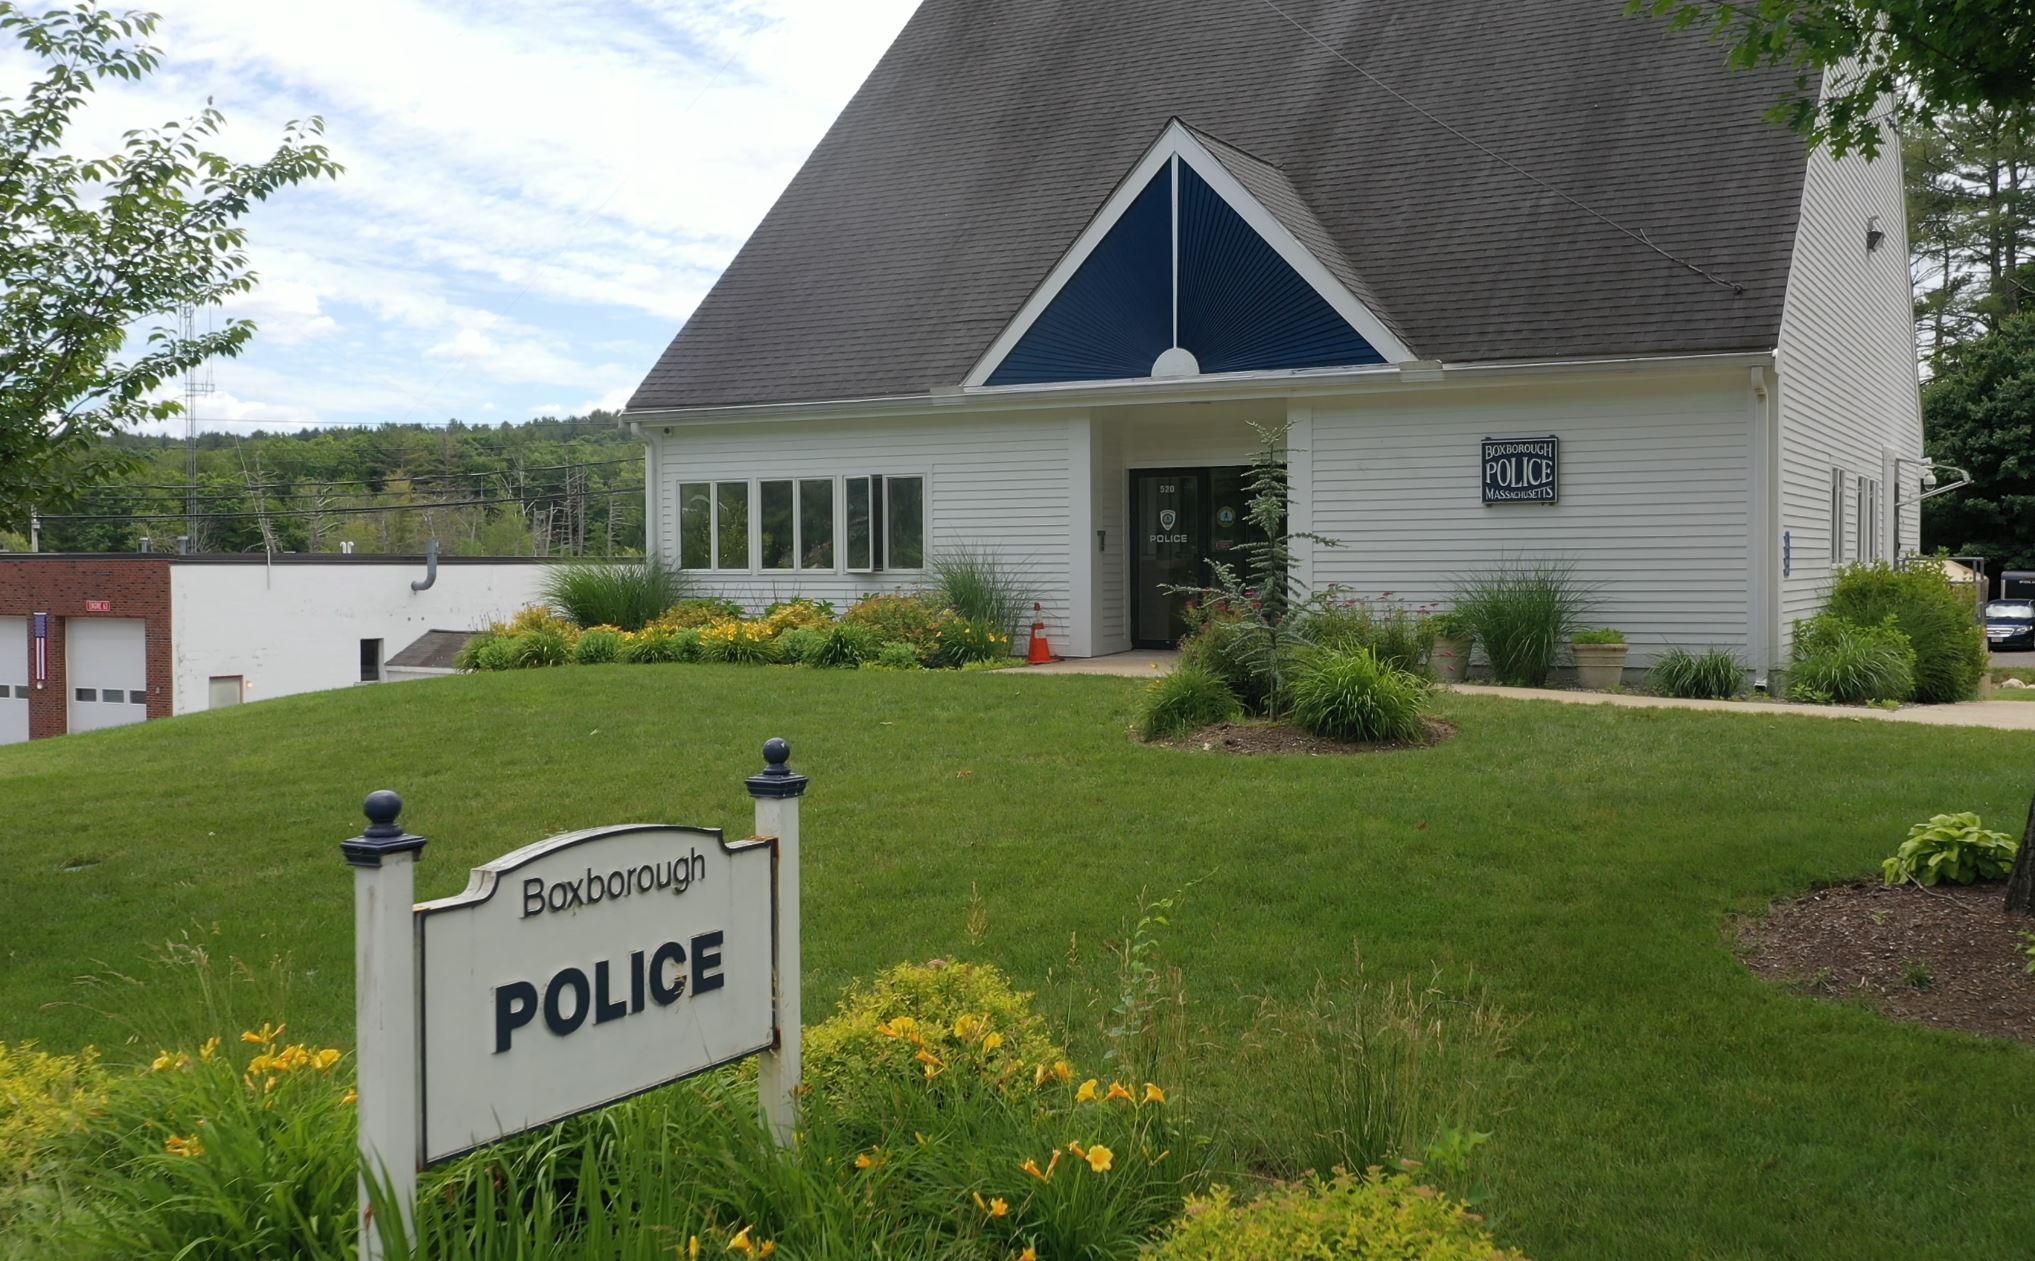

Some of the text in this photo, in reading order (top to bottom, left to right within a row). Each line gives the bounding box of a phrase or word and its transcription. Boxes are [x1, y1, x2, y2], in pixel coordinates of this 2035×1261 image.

[1485, 443, 1552, 460] BOXBOROUGH
[1485, 456, 1553, 488] POLICE
[1485, 486, 1553, 500] MASSACHUSETTS
[1149, 534, 1188, 543] POLICE
[522, 847, 706, 918] Boxborough
[494, 930, 725, 1054] POLICE
